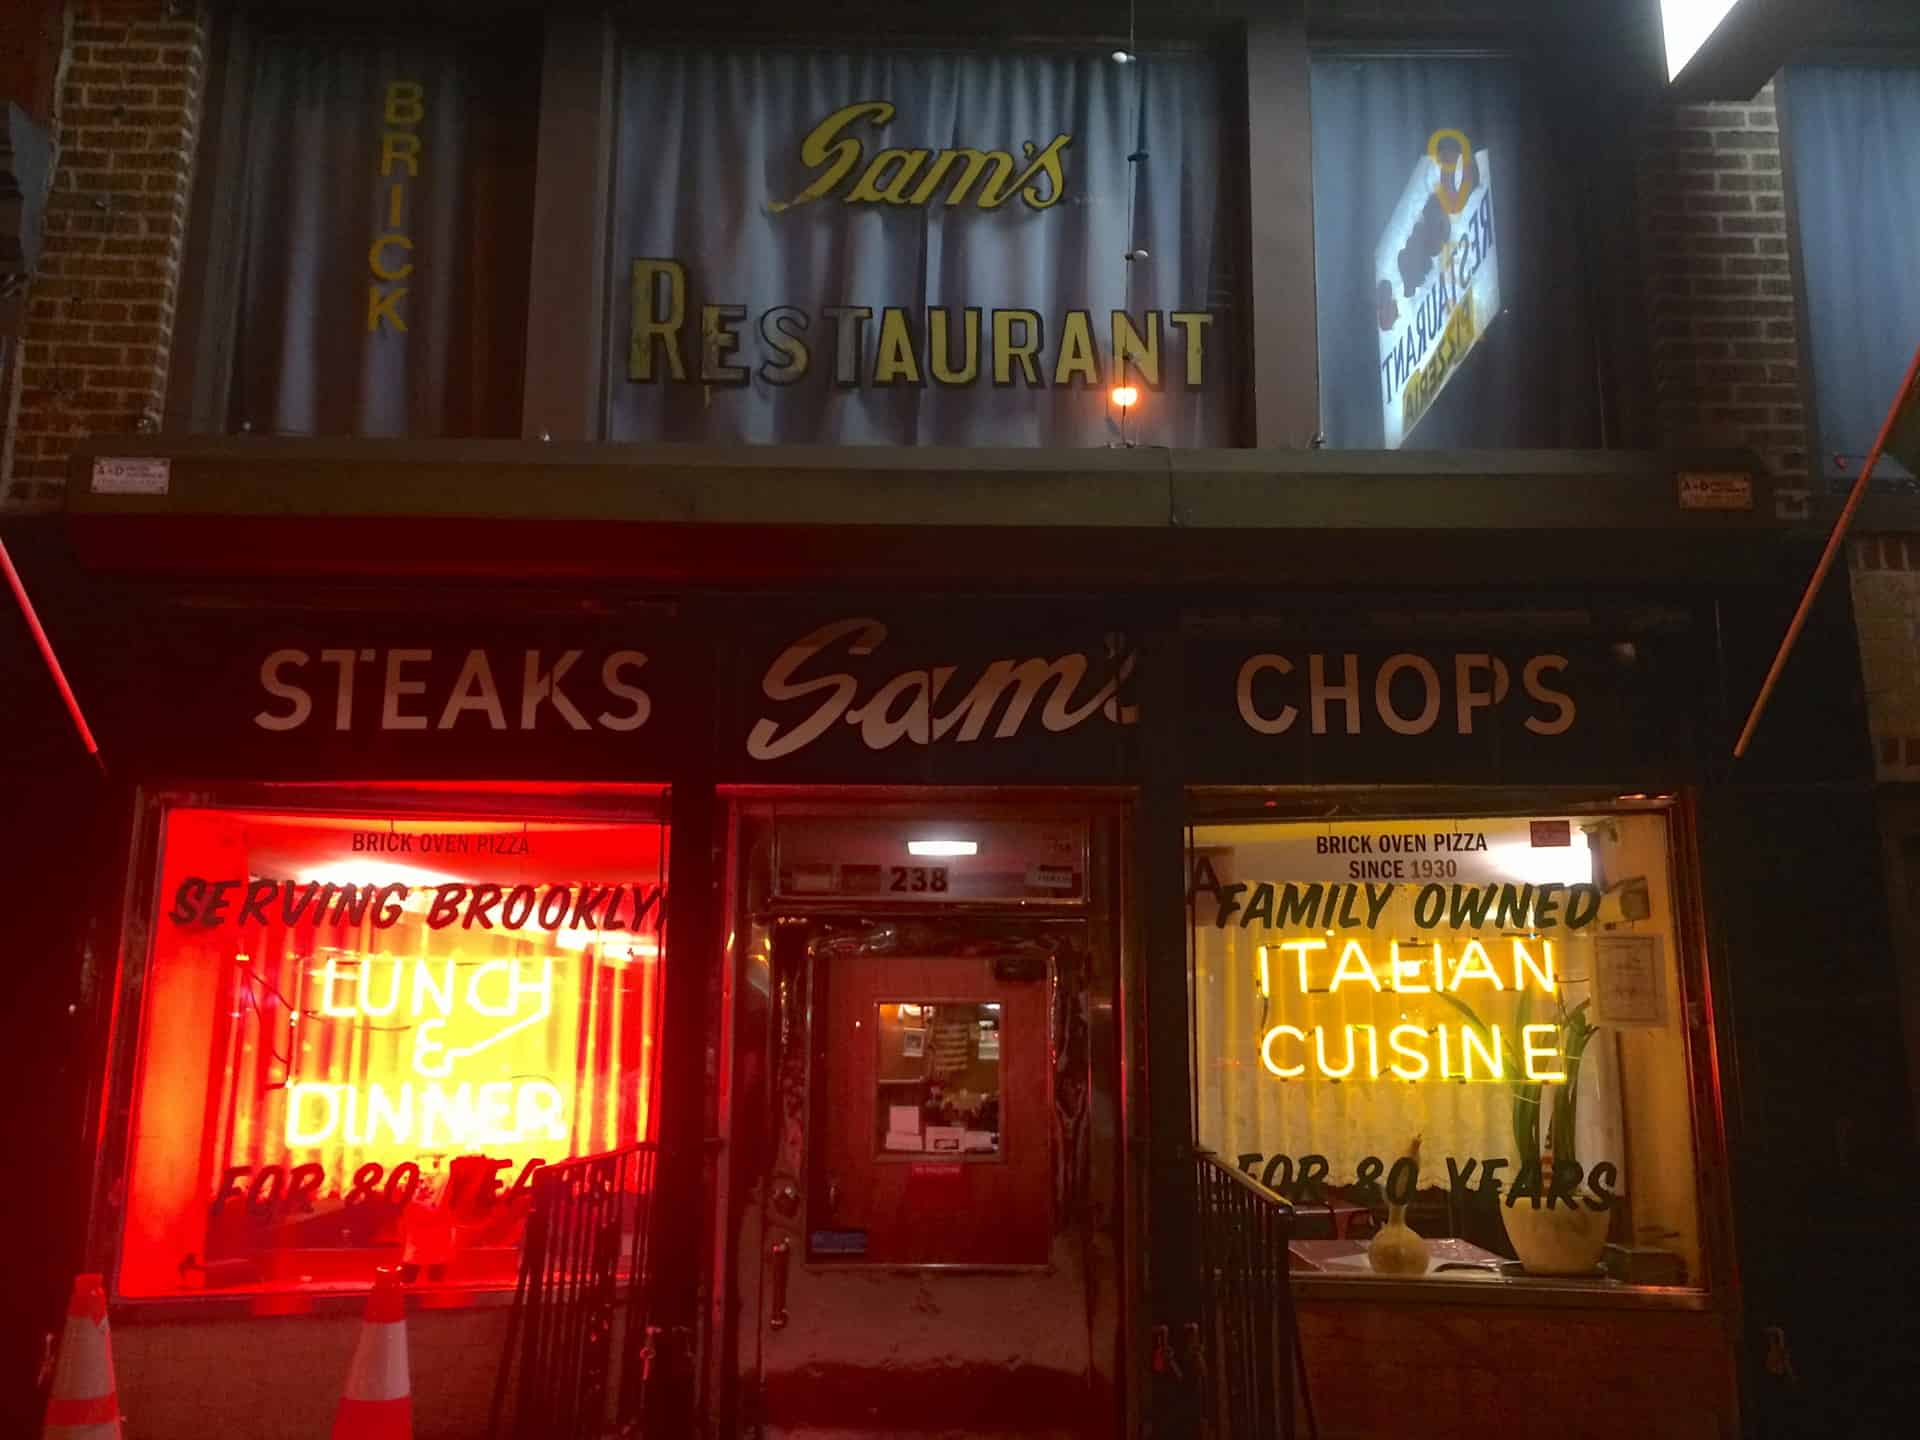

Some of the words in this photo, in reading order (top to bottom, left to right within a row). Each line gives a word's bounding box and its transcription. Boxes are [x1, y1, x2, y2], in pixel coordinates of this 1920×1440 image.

[767, 100, 1074, 212] Sam's
[367, 81, 424, 332] BRICK
[626, 257, 1213, 389] RESTAURANT
[253, 648, 652, 731] STEAKS
[1236, 653, 1576, 736] CHOPS
[352, 832, 412, 852] BRICK
[420, 833, 470, 853] OVEN
[478, 833, 528, 855] PIZZA
[1316, 835, 1373, 854] BRICK
[1379, 833, 1426, 853] OVEN
[1434, 832, 1488, 851] PIZZA
[1350, 860, 1404, 879] SINCE
[1410, 859, 1457, 878] 1930
[168, 877, 411, 929] SERVING
[890, 866, 948, 893] 238
[1215, 883, 1393, 930] FAMILY
[1413, 882, 1601, 930] OWNED
[322, 957, 552, 1017] LUNCH
[1256, 938, 1558, 998] ITALIAN
[1259, 1023, 1567, 1082] CUISINE
[285, 1081, 568, 1150] DINNER
[207, 1161, 326, 1217] FOR
[343, 1161, 421, 1206] 80
[1238, 1154, 1329, 1205] FOR
[1350, 1154, 1420, 1206] 80
[1445, 1157, 1618, 1212] YEARS
